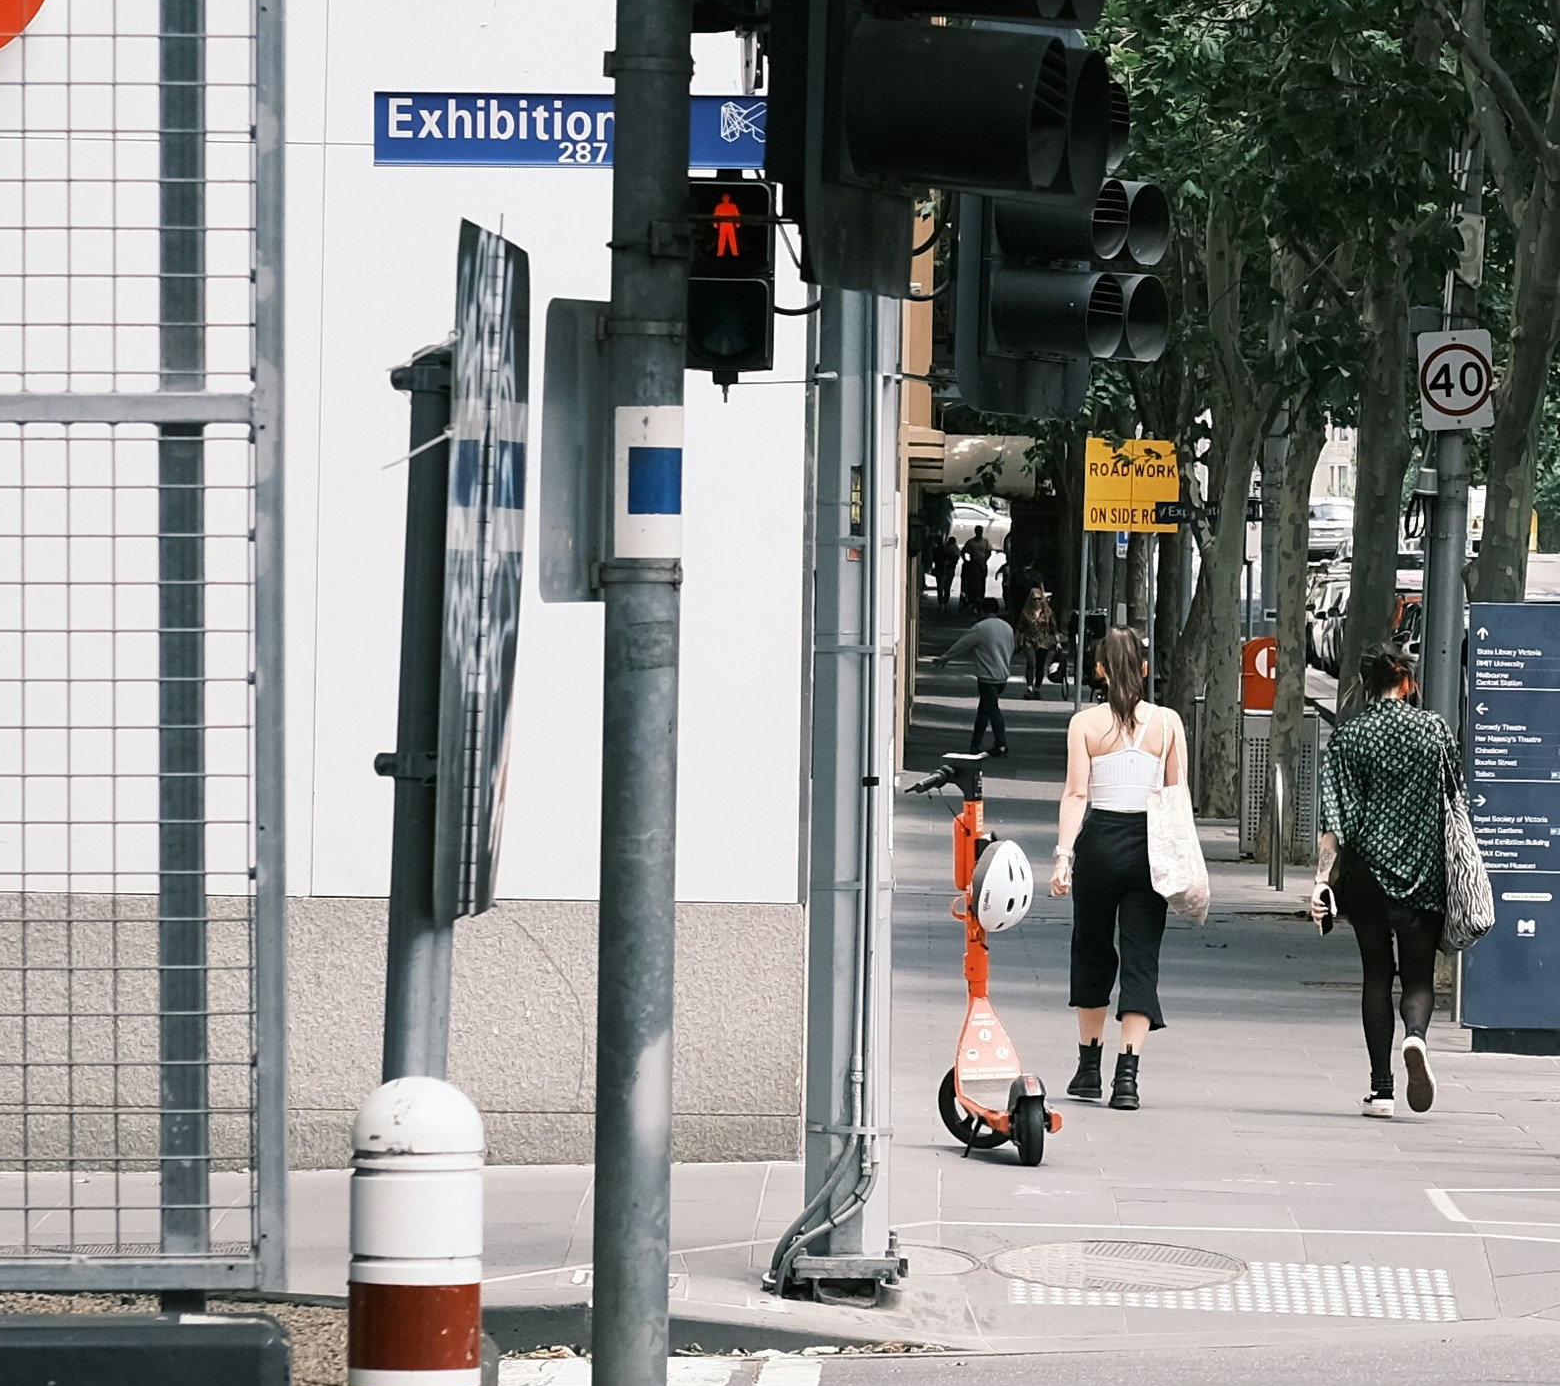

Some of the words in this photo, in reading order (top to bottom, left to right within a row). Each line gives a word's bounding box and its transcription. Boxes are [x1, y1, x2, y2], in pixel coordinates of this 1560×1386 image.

[557, 142, 609, 163] 287
[1428, 361, 1484, 397] 40
[1090, 462, 1130, 477] ROAD
[1134, 464, 1176, 478] WORK
[1090, 507, 1107, 524] ON
[1110, 508, 1139, 524] SIDE
[1495, 648, 1517, 658] Library
[1518, 649, 1542, 657] Victoria
[1494, 660, 1525, 669] University
[1476, 671, 1509, 679] Melbourne
[1476, 679, 1499, 687] Central
[1500, 680, 1523, 688] Station
[1475, 723, 1501, 732] Comedy
[1502, 724, 1527, 732] Theatre
[1474, 735, 1486, 743] Her
[1518, 736, 1542, 744] Theatre
[1475, 747, 1509, 755] Chinatown
[1498, 759, 1518, 767] Street
[1474, 770, 1496, 778] Toilets
[1473, 815, 1491, 824] Royal
[1492, 815, 1515, 824] Society
[1480, 850, 1494, 858] MAX
